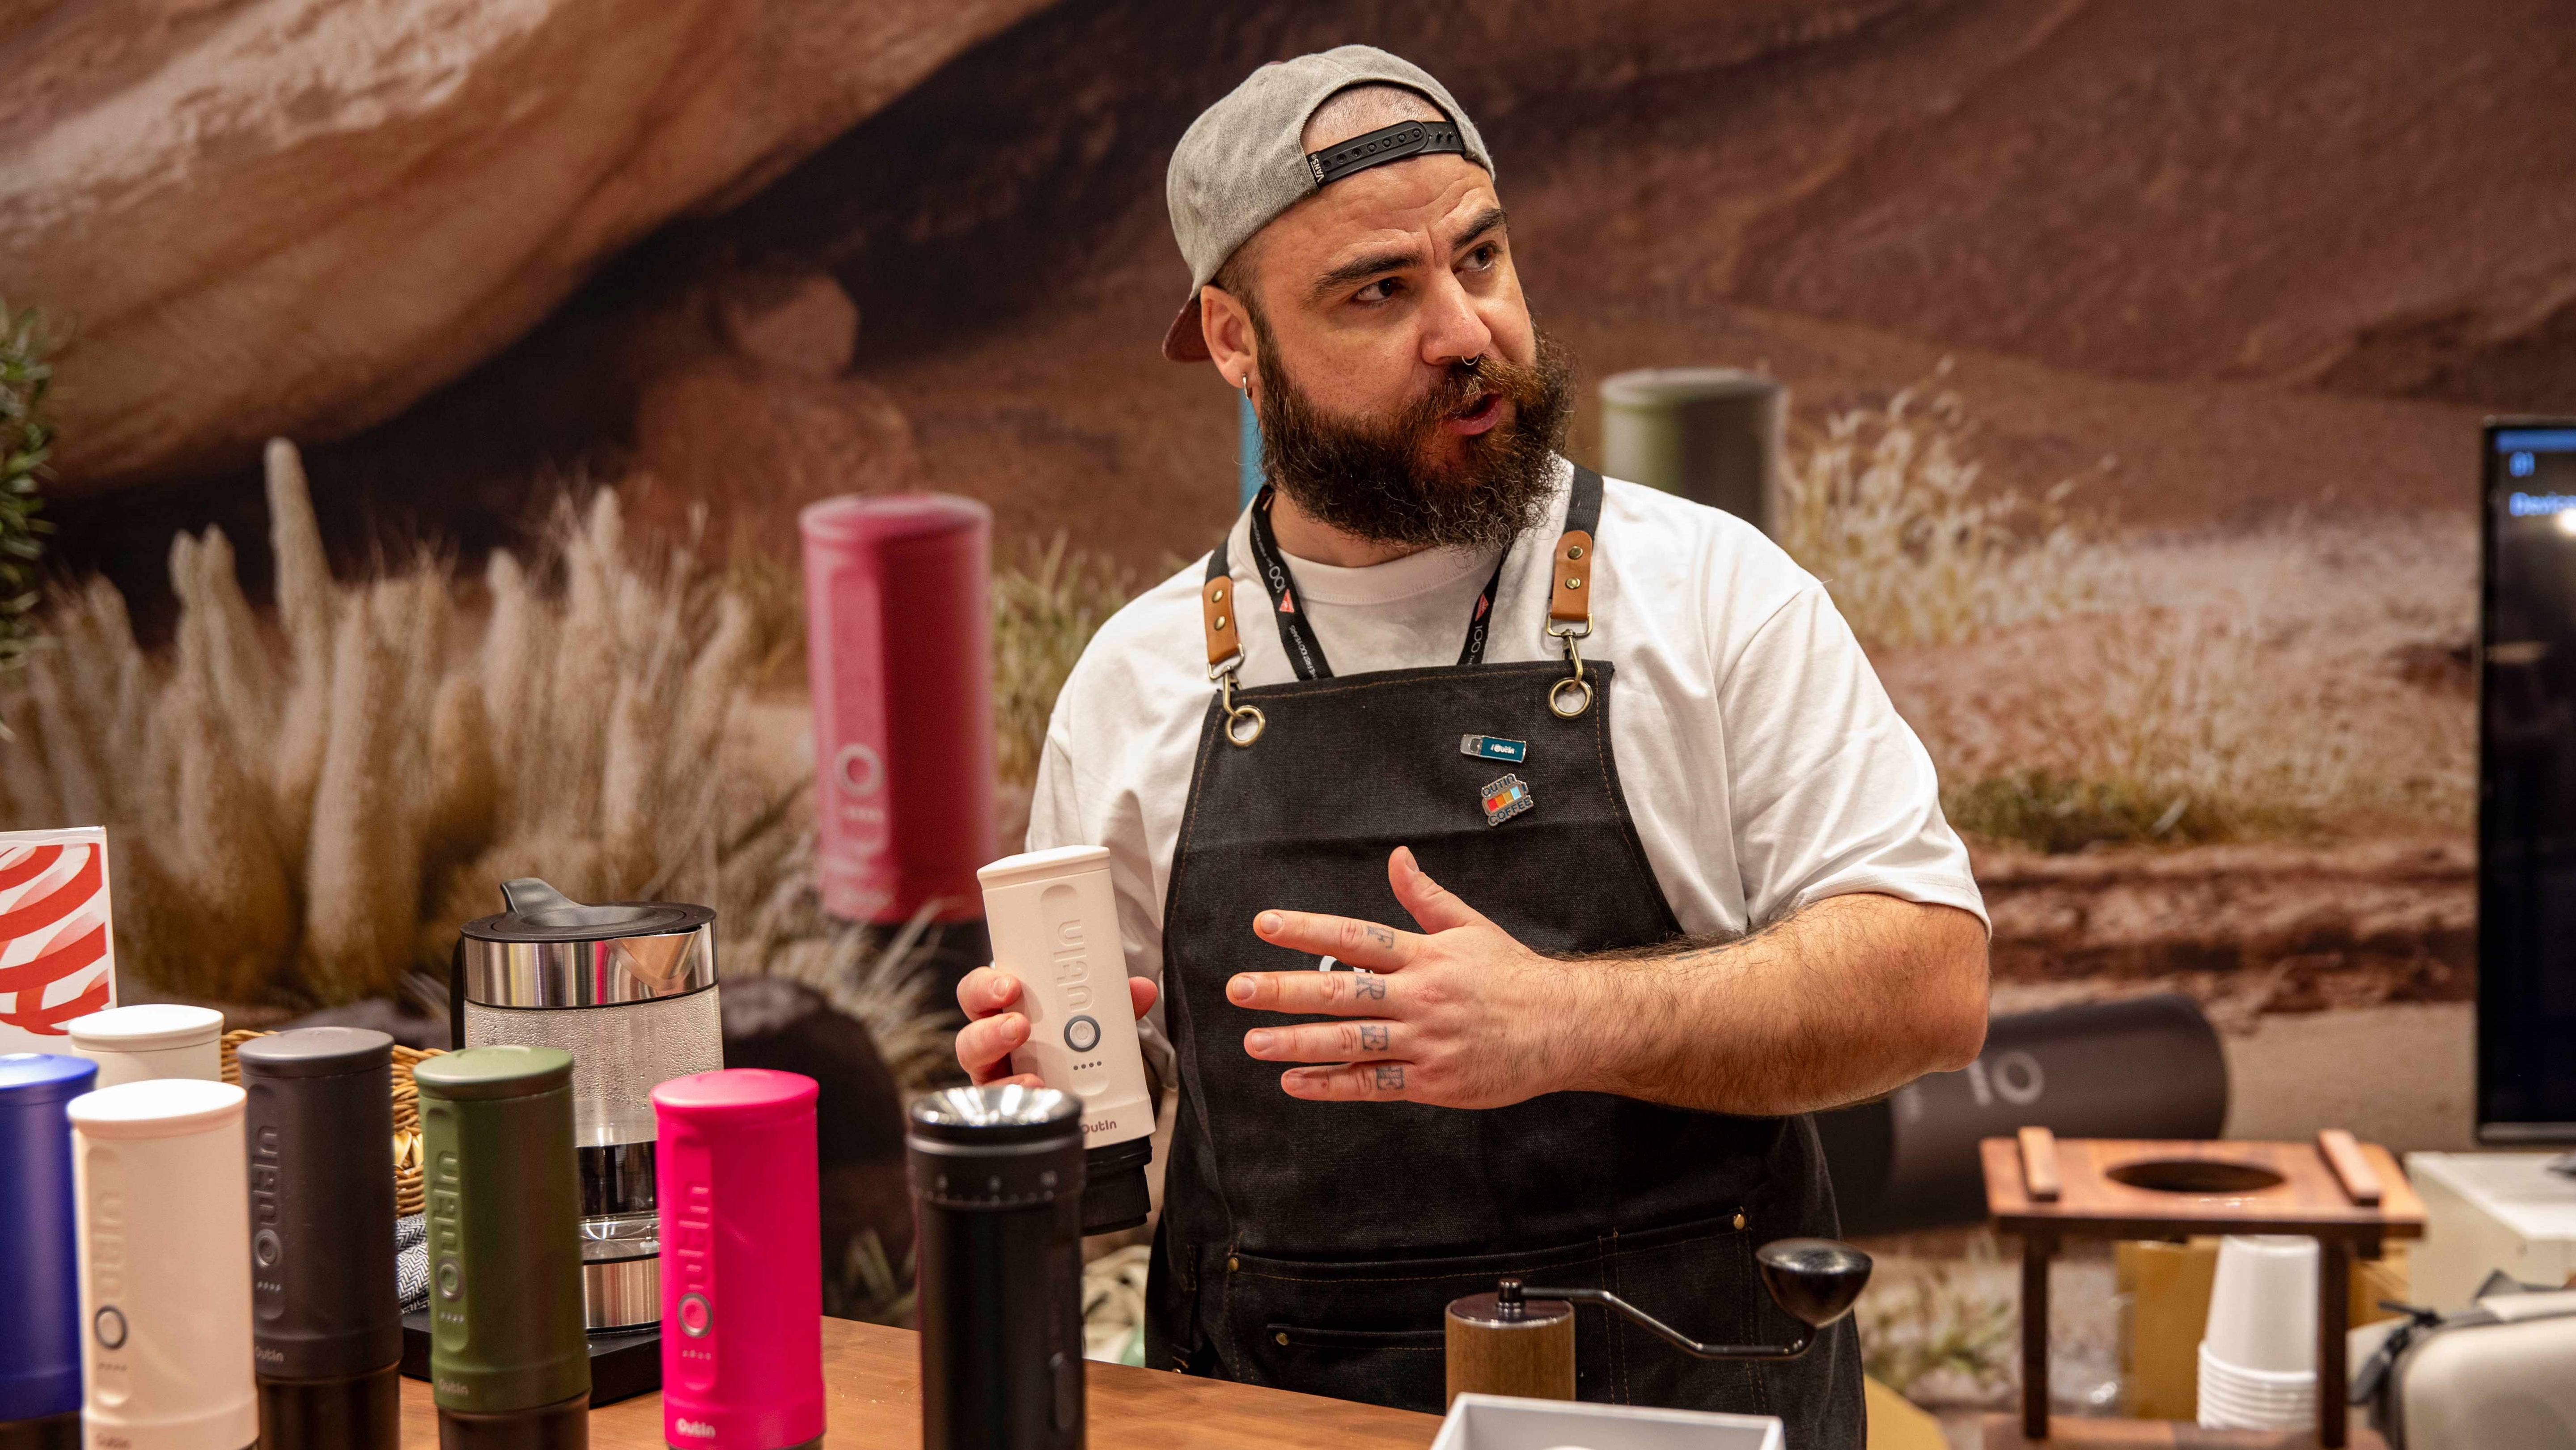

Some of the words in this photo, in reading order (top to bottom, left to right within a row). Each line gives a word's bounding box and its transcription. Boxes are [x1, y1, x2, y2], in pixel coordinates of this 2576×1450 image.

[1310, 158, 1324, 182] VANS
[1269, 566, 1286, 593] 100
[1289, 625, 1302, 645] YEARS
[1471, 625, 1483, 653] 100
[1299, 644, 1307, 656] 100
[1490, 798, 1531, 824] COFFEE
